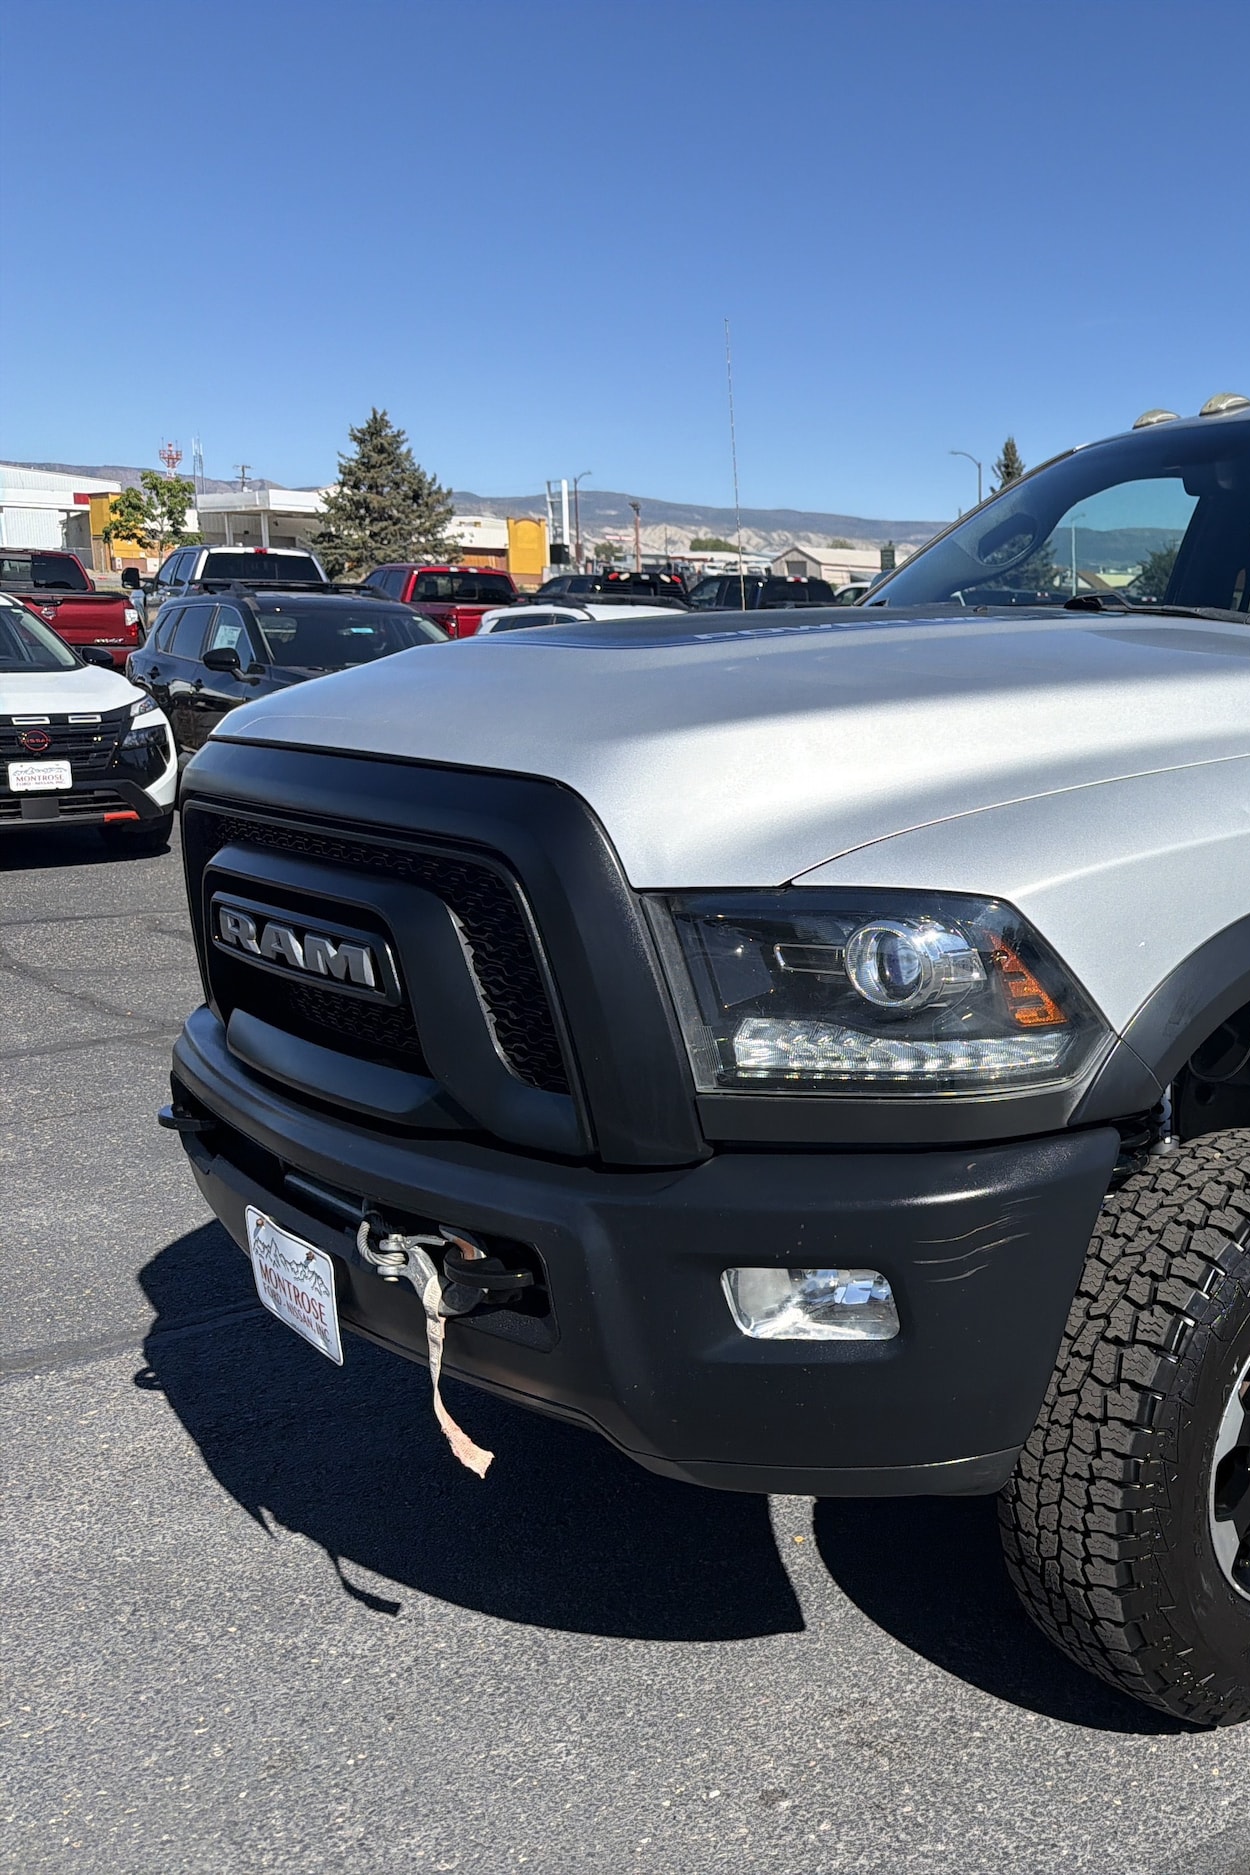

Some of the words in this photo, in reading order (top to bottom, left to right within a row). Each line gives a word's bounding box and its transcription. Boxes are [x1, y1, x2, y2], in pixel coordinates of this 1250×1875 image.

[15, 774, 64, 782] MONTROSE
[219, 905, 376, 988] RAM
[258, 1259, 328, 1327] MONTROSE
[263, 1282, 282, 1307] FORD
